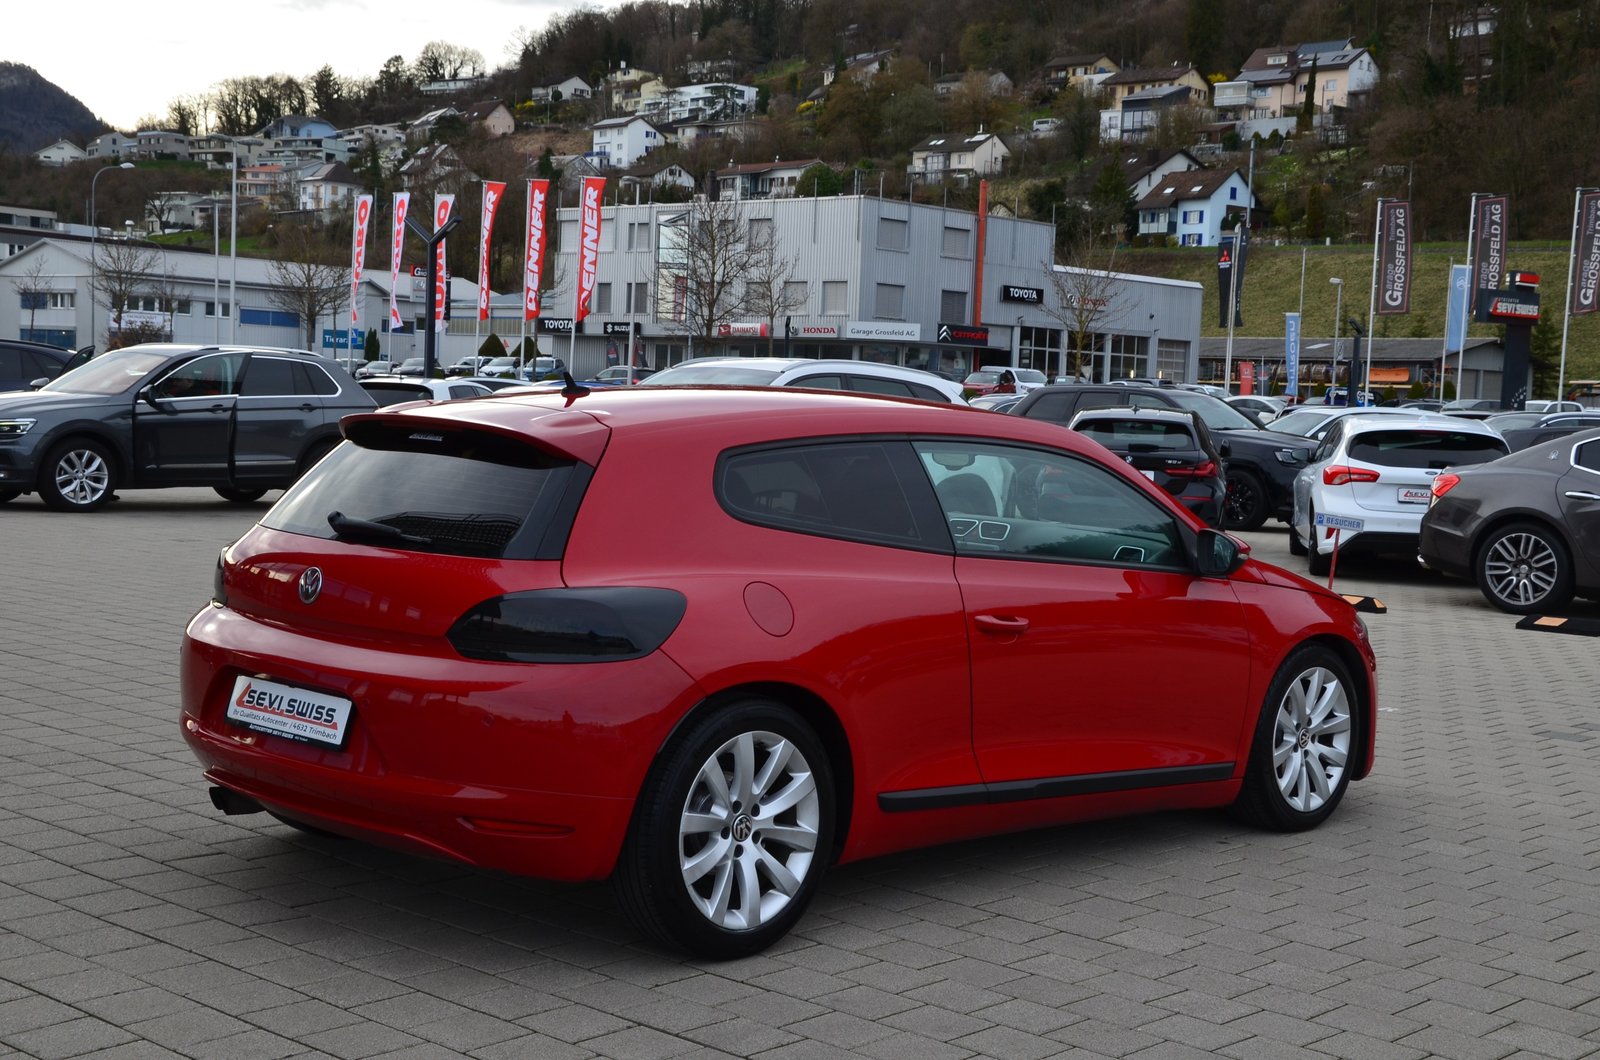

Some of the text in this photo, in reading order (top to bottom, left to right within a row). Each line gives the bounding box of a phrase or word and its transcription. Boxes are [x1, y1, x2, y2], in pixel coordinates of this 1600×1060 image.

[352, 199, 369, 322] MBO
[526, 189, 545, 311] DENNER
[1385, 208, 1405, 306] GROSSFELD AG
[1488, 204, 1501, 289] ROSSFELD AG
[1009, 288, 1037, 299] TOYOTA
[544, 320, 573, 329] TOYOTA
[851, 328, 873, 336] Garage
[875, 329, 904, 337] Grossfeld
[1326, 516, 1361, 529] BESUCHER
[245, 689, 336, 724] SEVI SWISS
[261, 715, 288, 727] Autocenter
[293, 722, 308, 732] 4632
[309, 727, 337, 740] Trimbach
